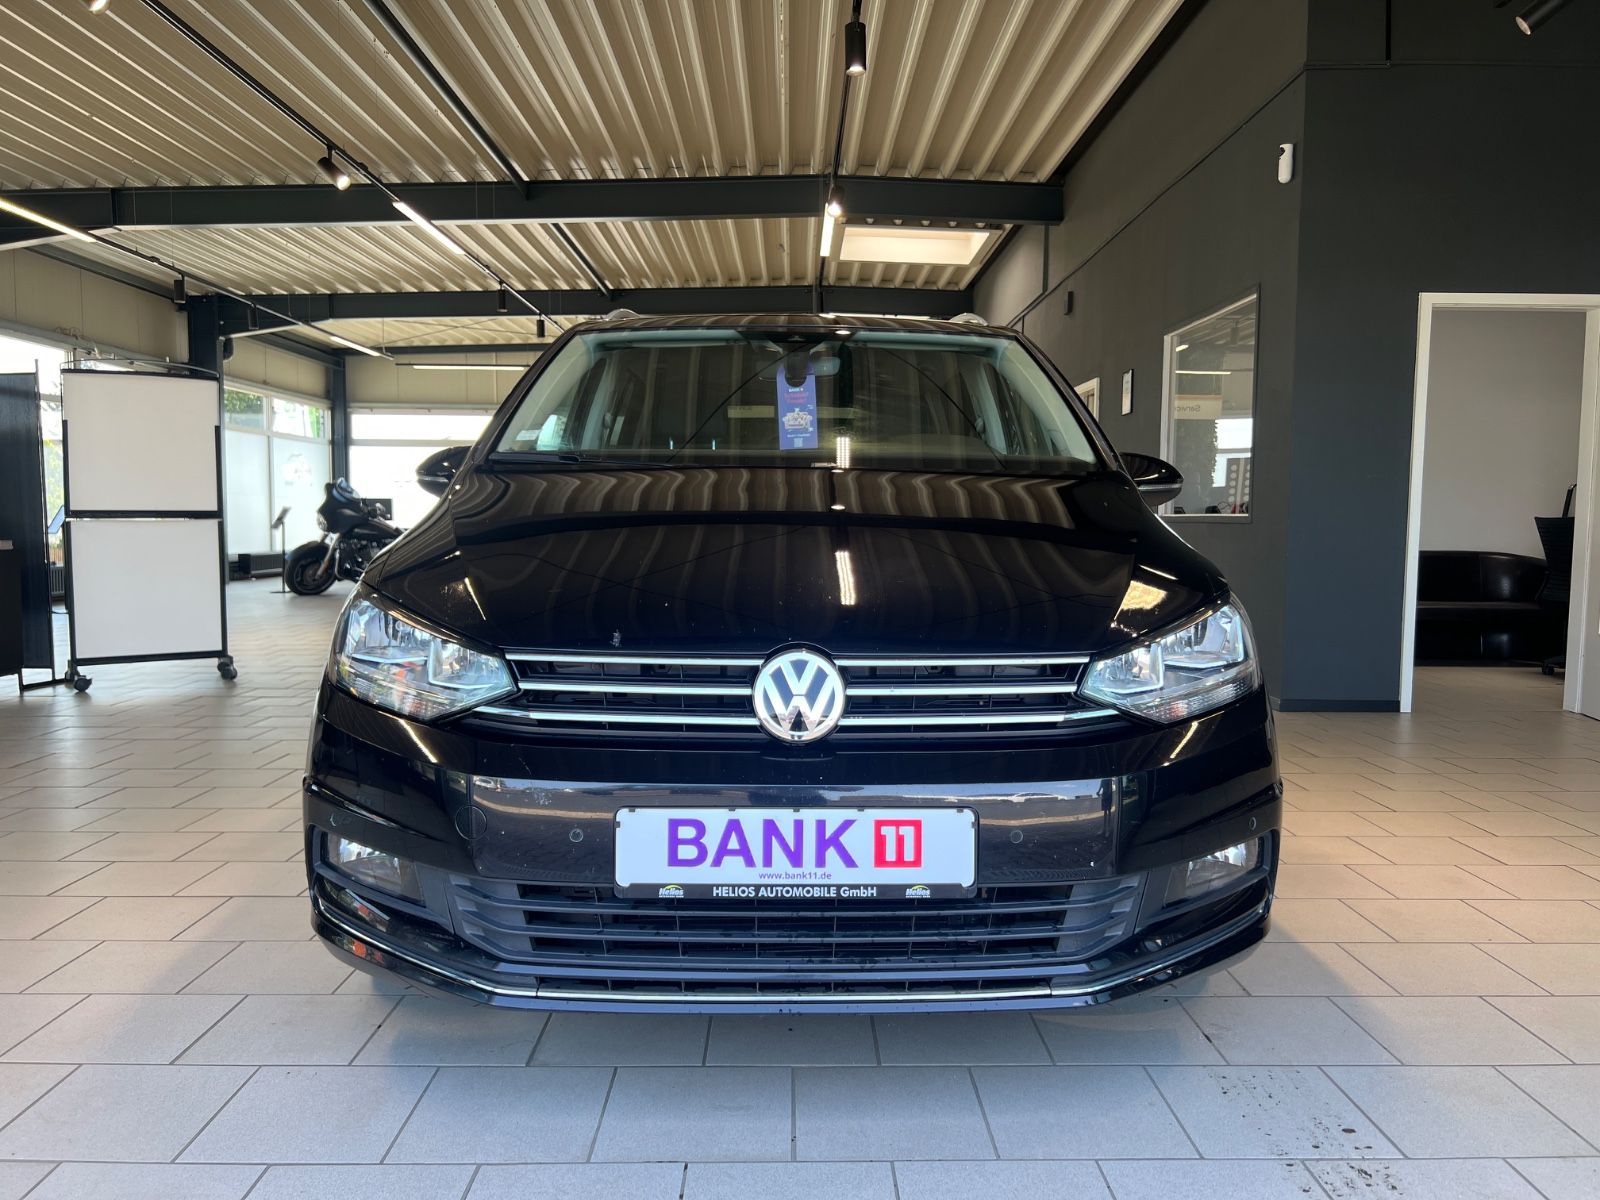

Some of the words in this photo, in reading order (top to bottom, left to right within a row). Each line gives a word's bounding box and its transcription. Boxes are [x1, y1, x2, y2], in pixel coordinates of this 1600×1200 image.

[755, 652, 844, 740] VW
[667, 818, 859, 868] BANK
[879, 825, 915, 862] 11
[758, 871, 832, 880] www.bank11.de
[659, 886, 684, 896] Helios
[712, 886, 755, 898] HELIOS
[758, 886, 837, 898] AUTOMOBILE
[840, 886, 877, 898] GmbH
[905, 887, 931, 896] Helios
